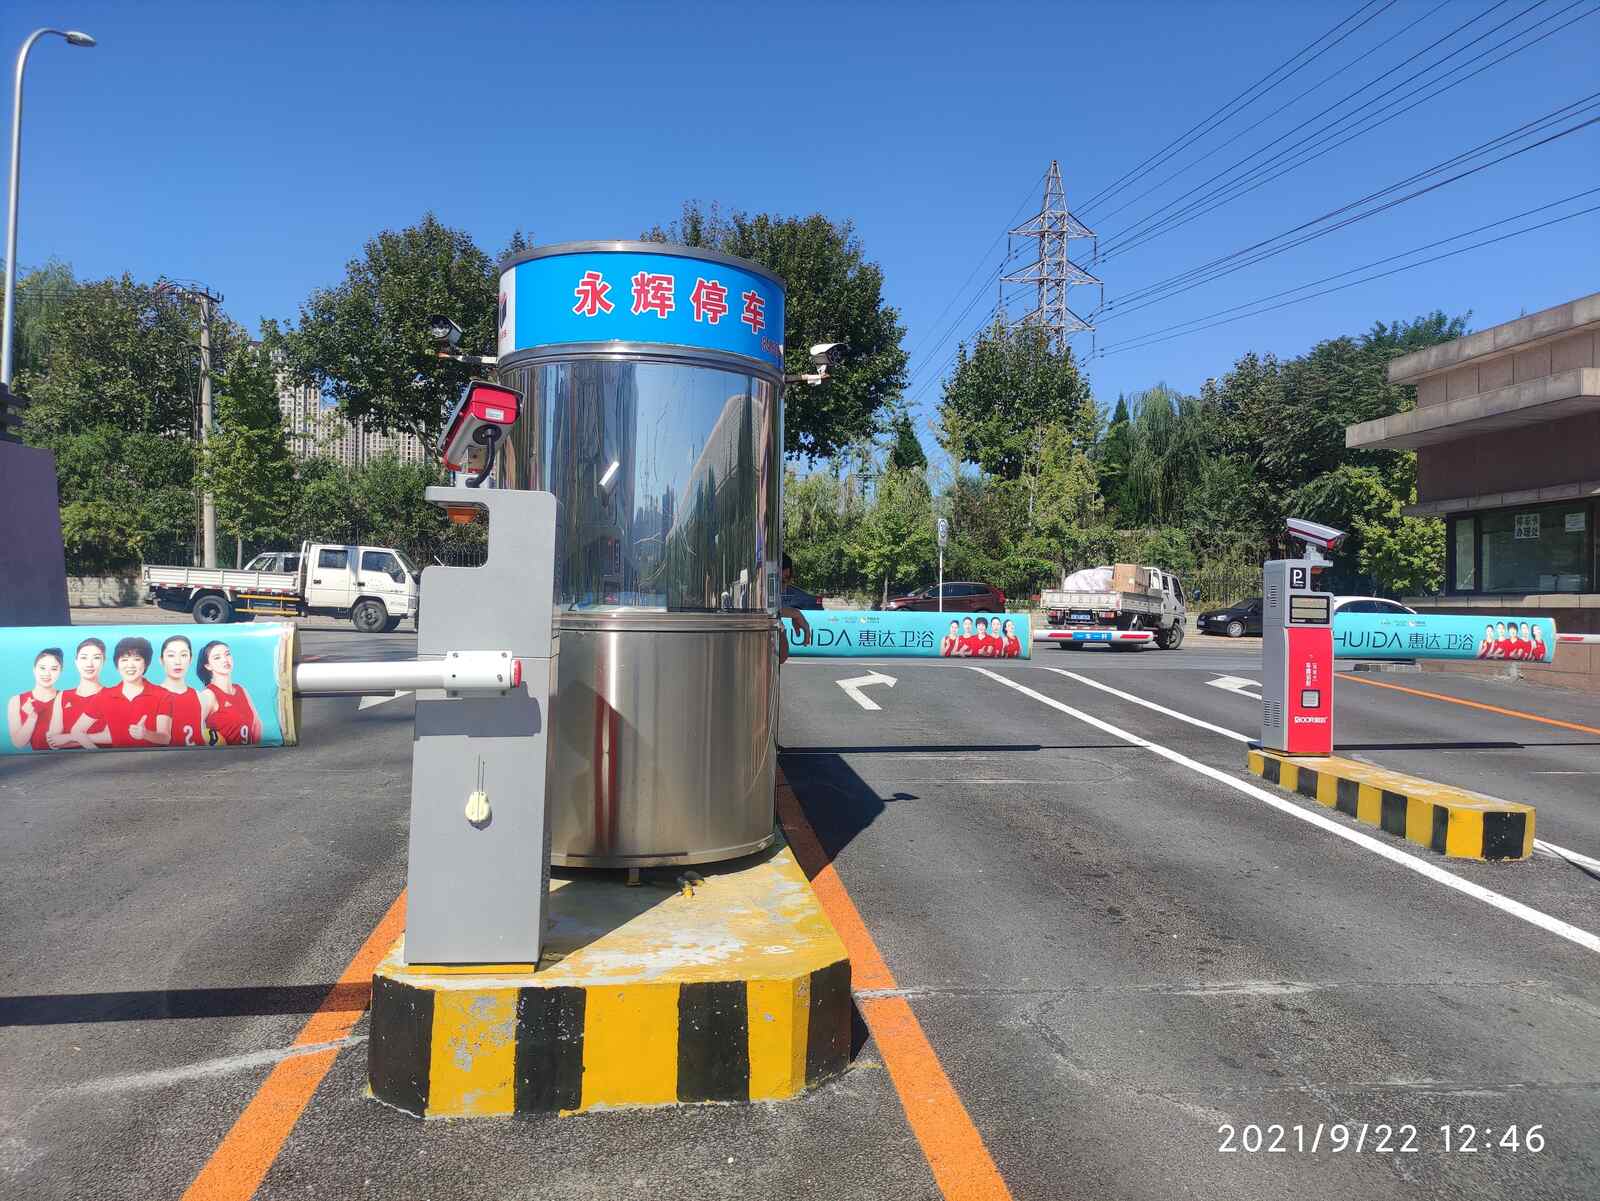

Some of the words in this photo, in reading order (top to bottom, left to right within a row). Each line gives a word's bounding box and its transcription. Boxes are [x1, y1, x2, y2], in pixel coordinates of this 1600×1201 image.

[572, 270, 766, 335] 永辉停车
[858, 629, 934, 648] 惠达卫浴
[1333, 631, 1403, 648] HUIDA
[1408, 632, 1474, 651] 惠达卫浴
